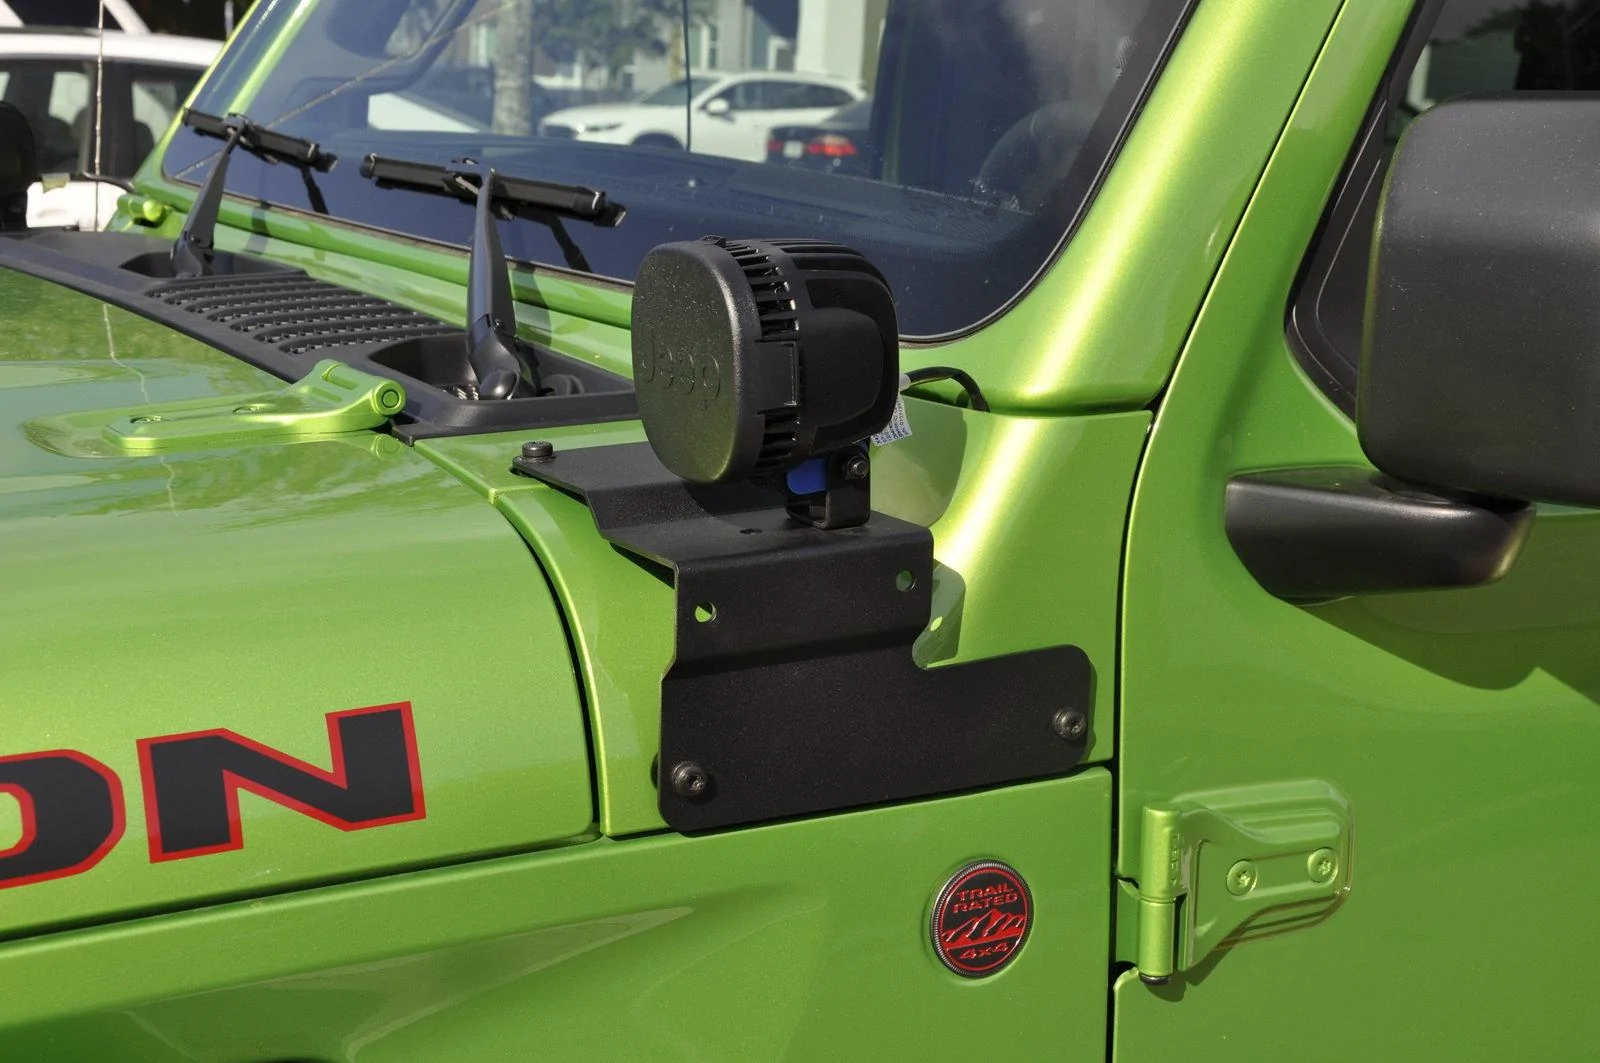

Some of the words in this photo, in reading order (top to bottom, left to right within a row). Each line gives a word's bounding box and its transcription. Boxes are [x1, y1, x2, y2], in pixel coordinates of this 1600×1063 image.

[640, 330, 721, 411] Jeep
[956, 883, 1013, 900] TRAIL
[952, 892, 1017, 913] RATED
